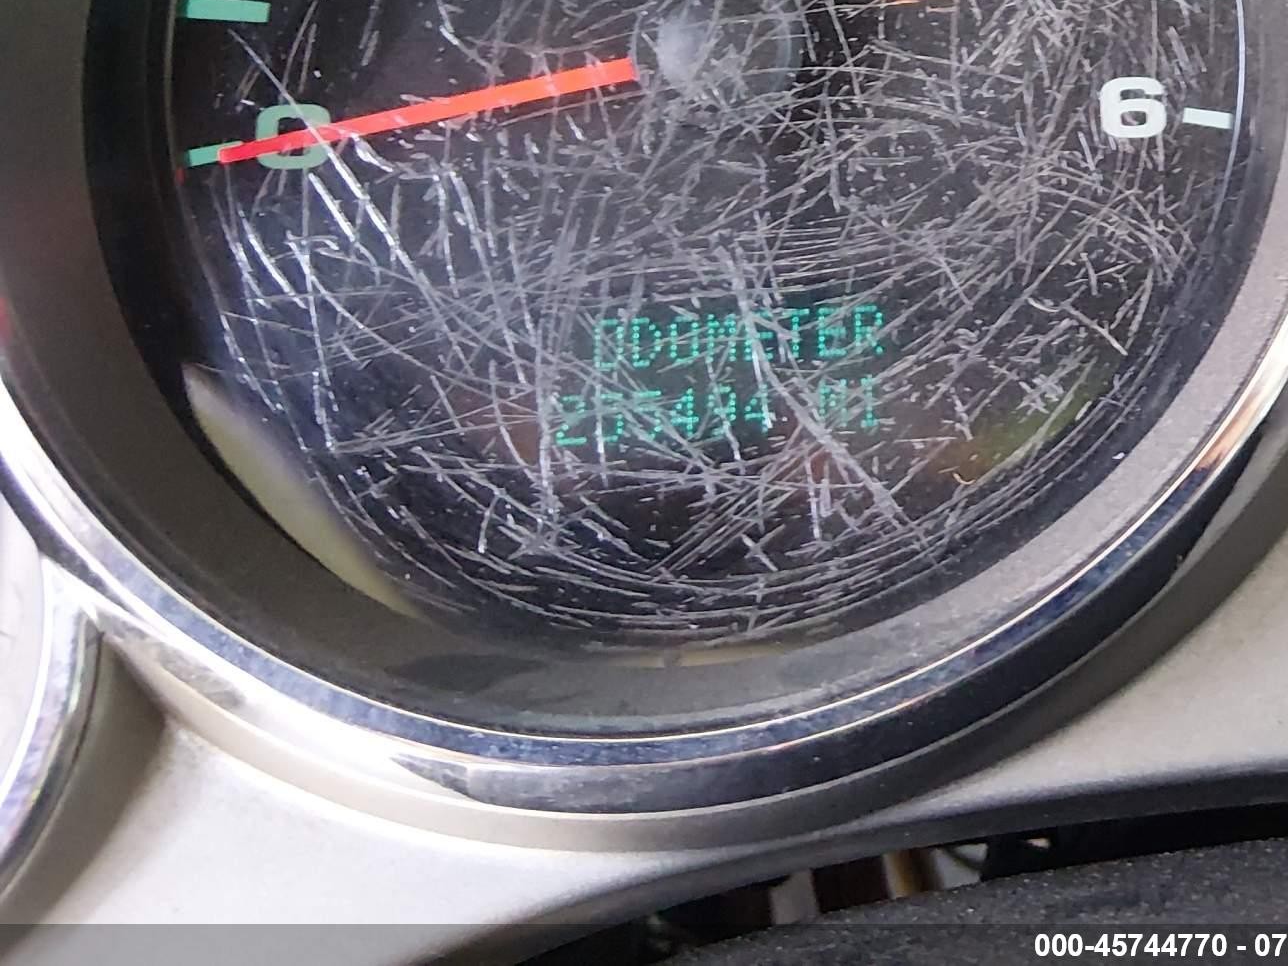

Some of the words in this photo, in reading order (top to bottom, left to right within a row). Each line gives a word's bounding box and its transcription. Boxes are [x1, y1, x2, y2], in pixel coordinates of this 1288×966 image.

[255, 102, 332, 169] 0
[1098, 76, 1168, 138] 6
[593, 304, 886, 372] ODOMETER
[818, 374, 877, 430] MI
